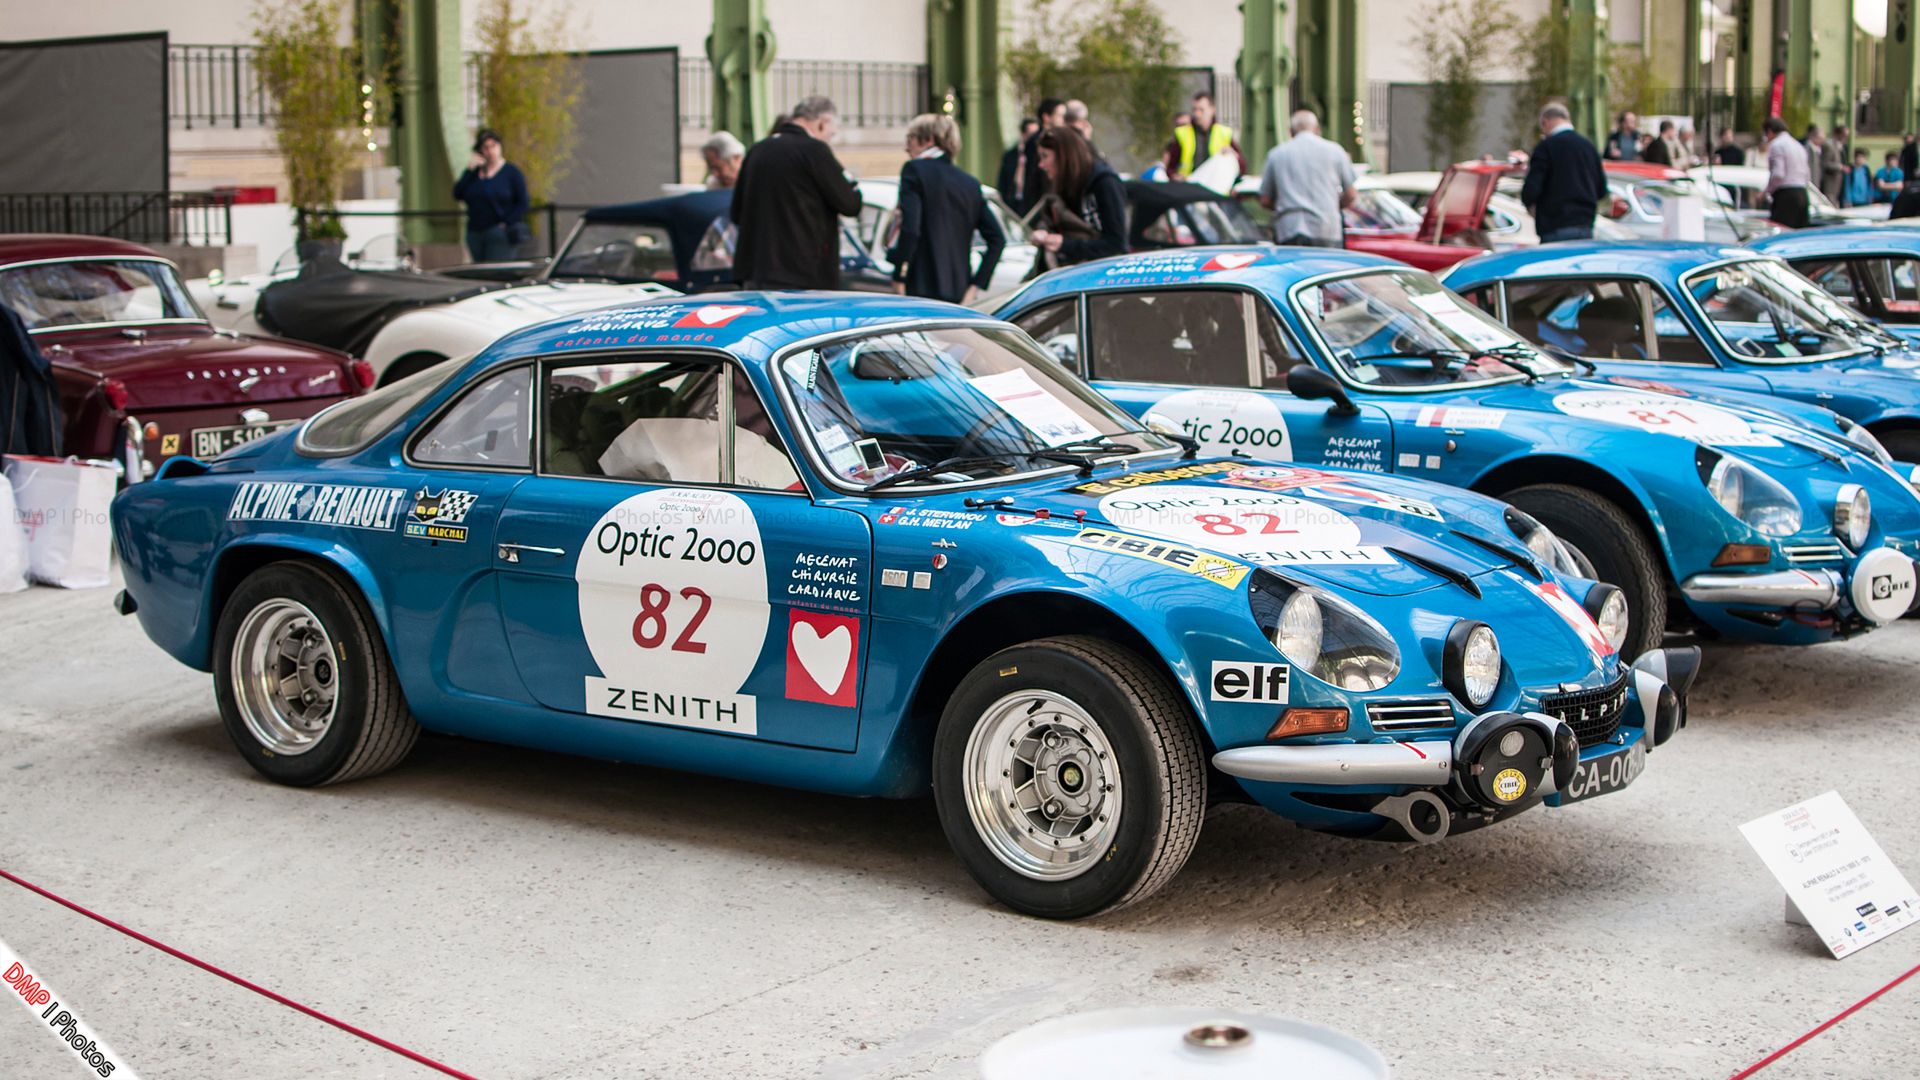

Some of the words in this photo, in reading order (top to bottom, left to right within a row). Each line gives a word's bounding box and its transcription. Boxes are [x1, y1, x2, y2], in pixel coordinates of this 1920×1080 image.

[567, 319, 671, 335] CARDIAQUE
[555, 336, 620, 348] enfants
[627, 333, 649, 343] du
[656, 332, 715, 343] monde
[1627, 409, 1699, 424] 81
[1182, 418, 1212, 443] tic
[1219, 419, 1283, 448] 2000
[229, 482, 305, 520] ALPINE
[310, 486, 402, 529] RENAULT
[1109, 496, 1203, 512] Optic
[1210, 497, 1301, 506] 2000
[905, 508, 916, 517] J.
[918, 508, 988, 523] STERVINOU
[922, 518, 973, 531] MEYLAN
[1192, 511, 1300, 536] 82
[427, 526, 465, 540] MARCHAL
[597, 521, 675, 566] Optic
[680, 527, 756, 566] 2000
[1078, 531, 1199, 567] CIBIE
[795, 552, 858, 568] MECENAT
[791, 567, 858, 585] CHIRURGIE
[787, 583, 861, 601] CARDIAQUE
[1880, 580, 1909, 593] CIBIE
[631, 582, 712, 654] 82
[1213, 665, 1288, 700] elf
[606, 687, 738, 724] ZENITH
[1560, 686, 1629, 723] ALPI
